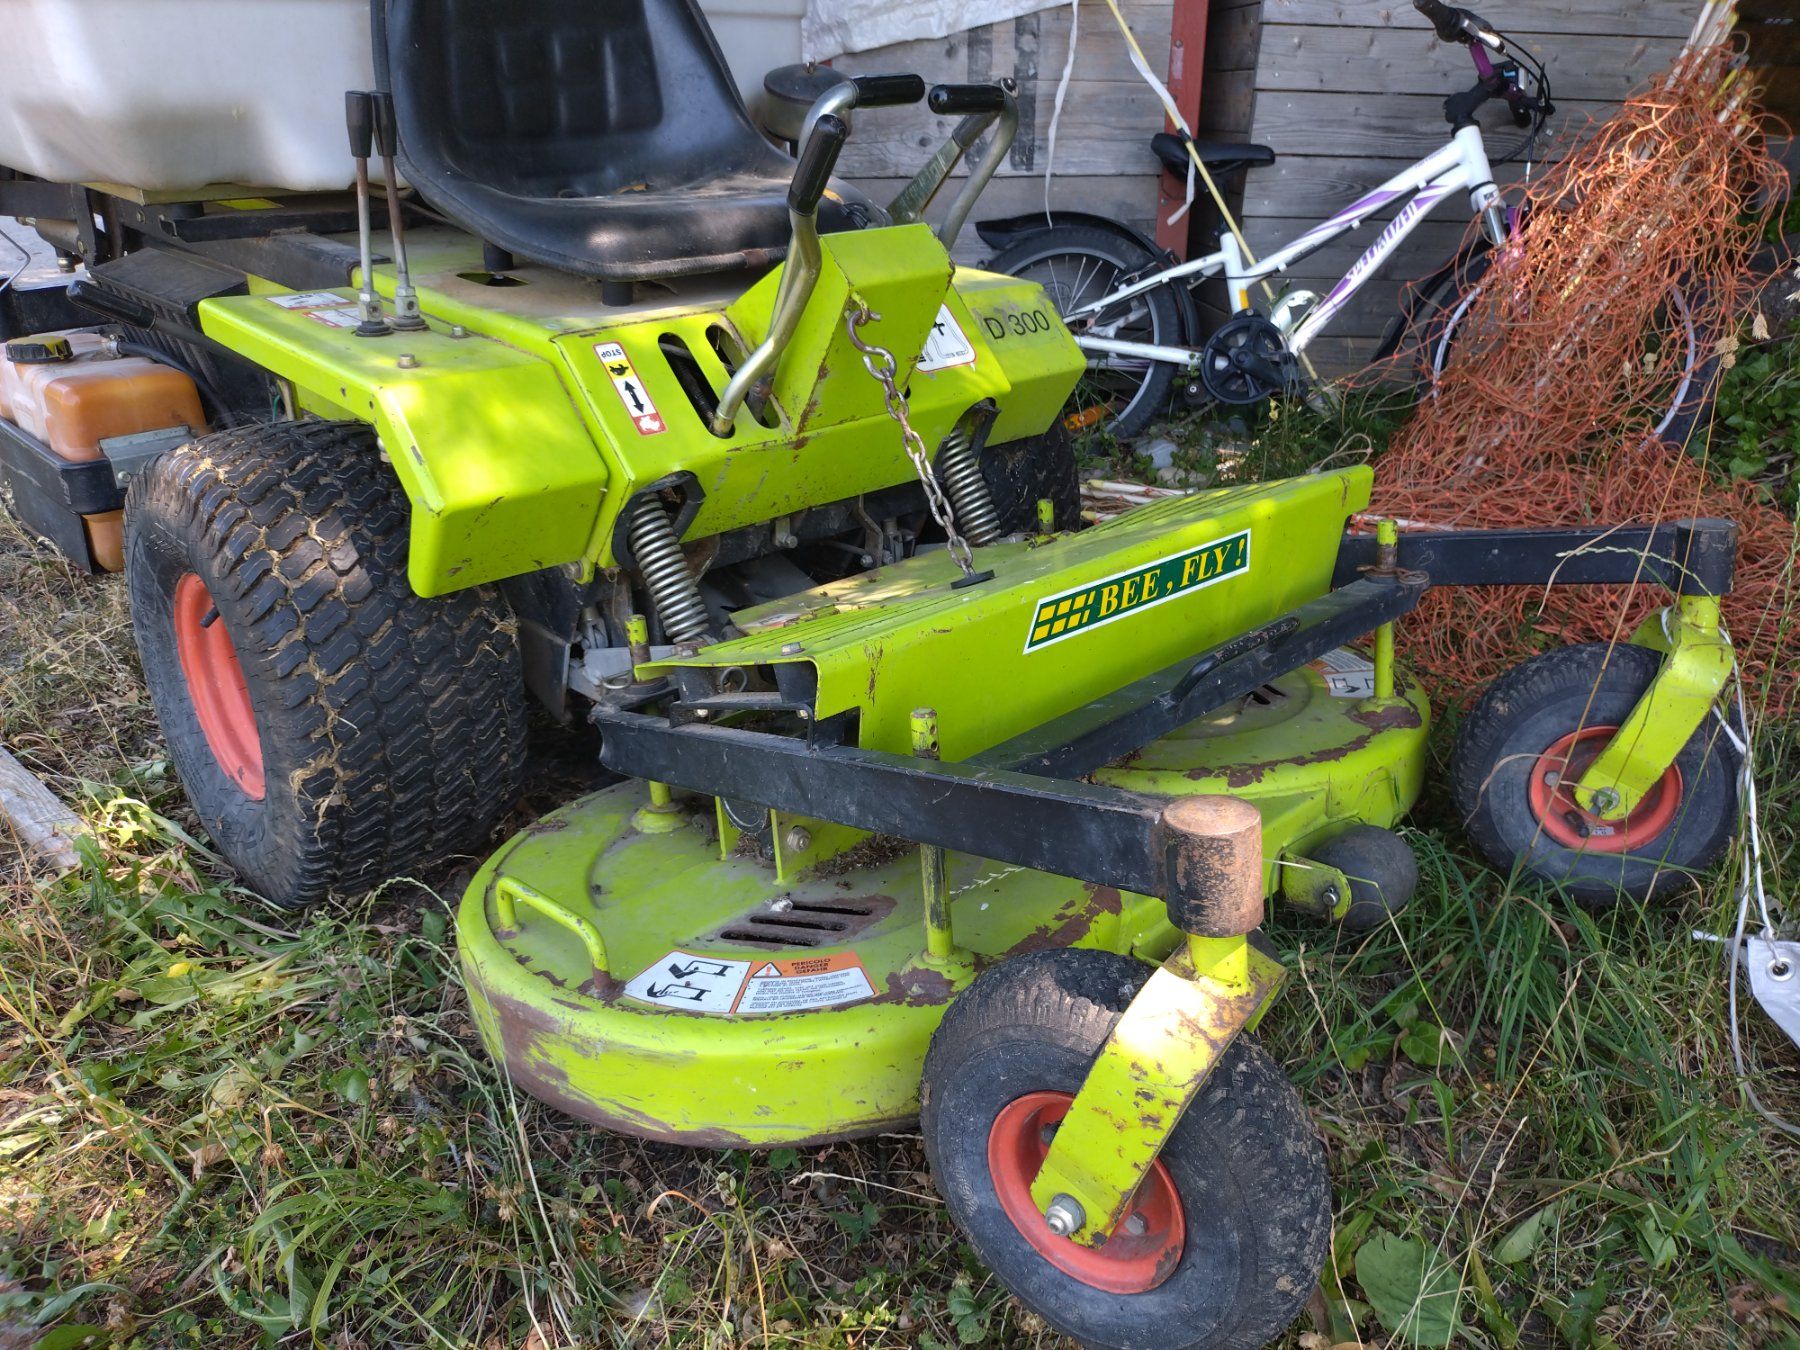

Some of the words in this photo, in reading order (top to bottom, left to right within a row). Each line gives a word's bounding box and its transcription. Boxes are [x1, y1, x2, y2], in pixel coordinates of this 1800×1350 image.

[983, 317, 1006, 339] D
[1007, 309, 1050, 335] 300
[600, 348, 623, 358] STOP
[791, 958, 831, 967] PERICOLO
[794, 962, 829, 970] DANGER
